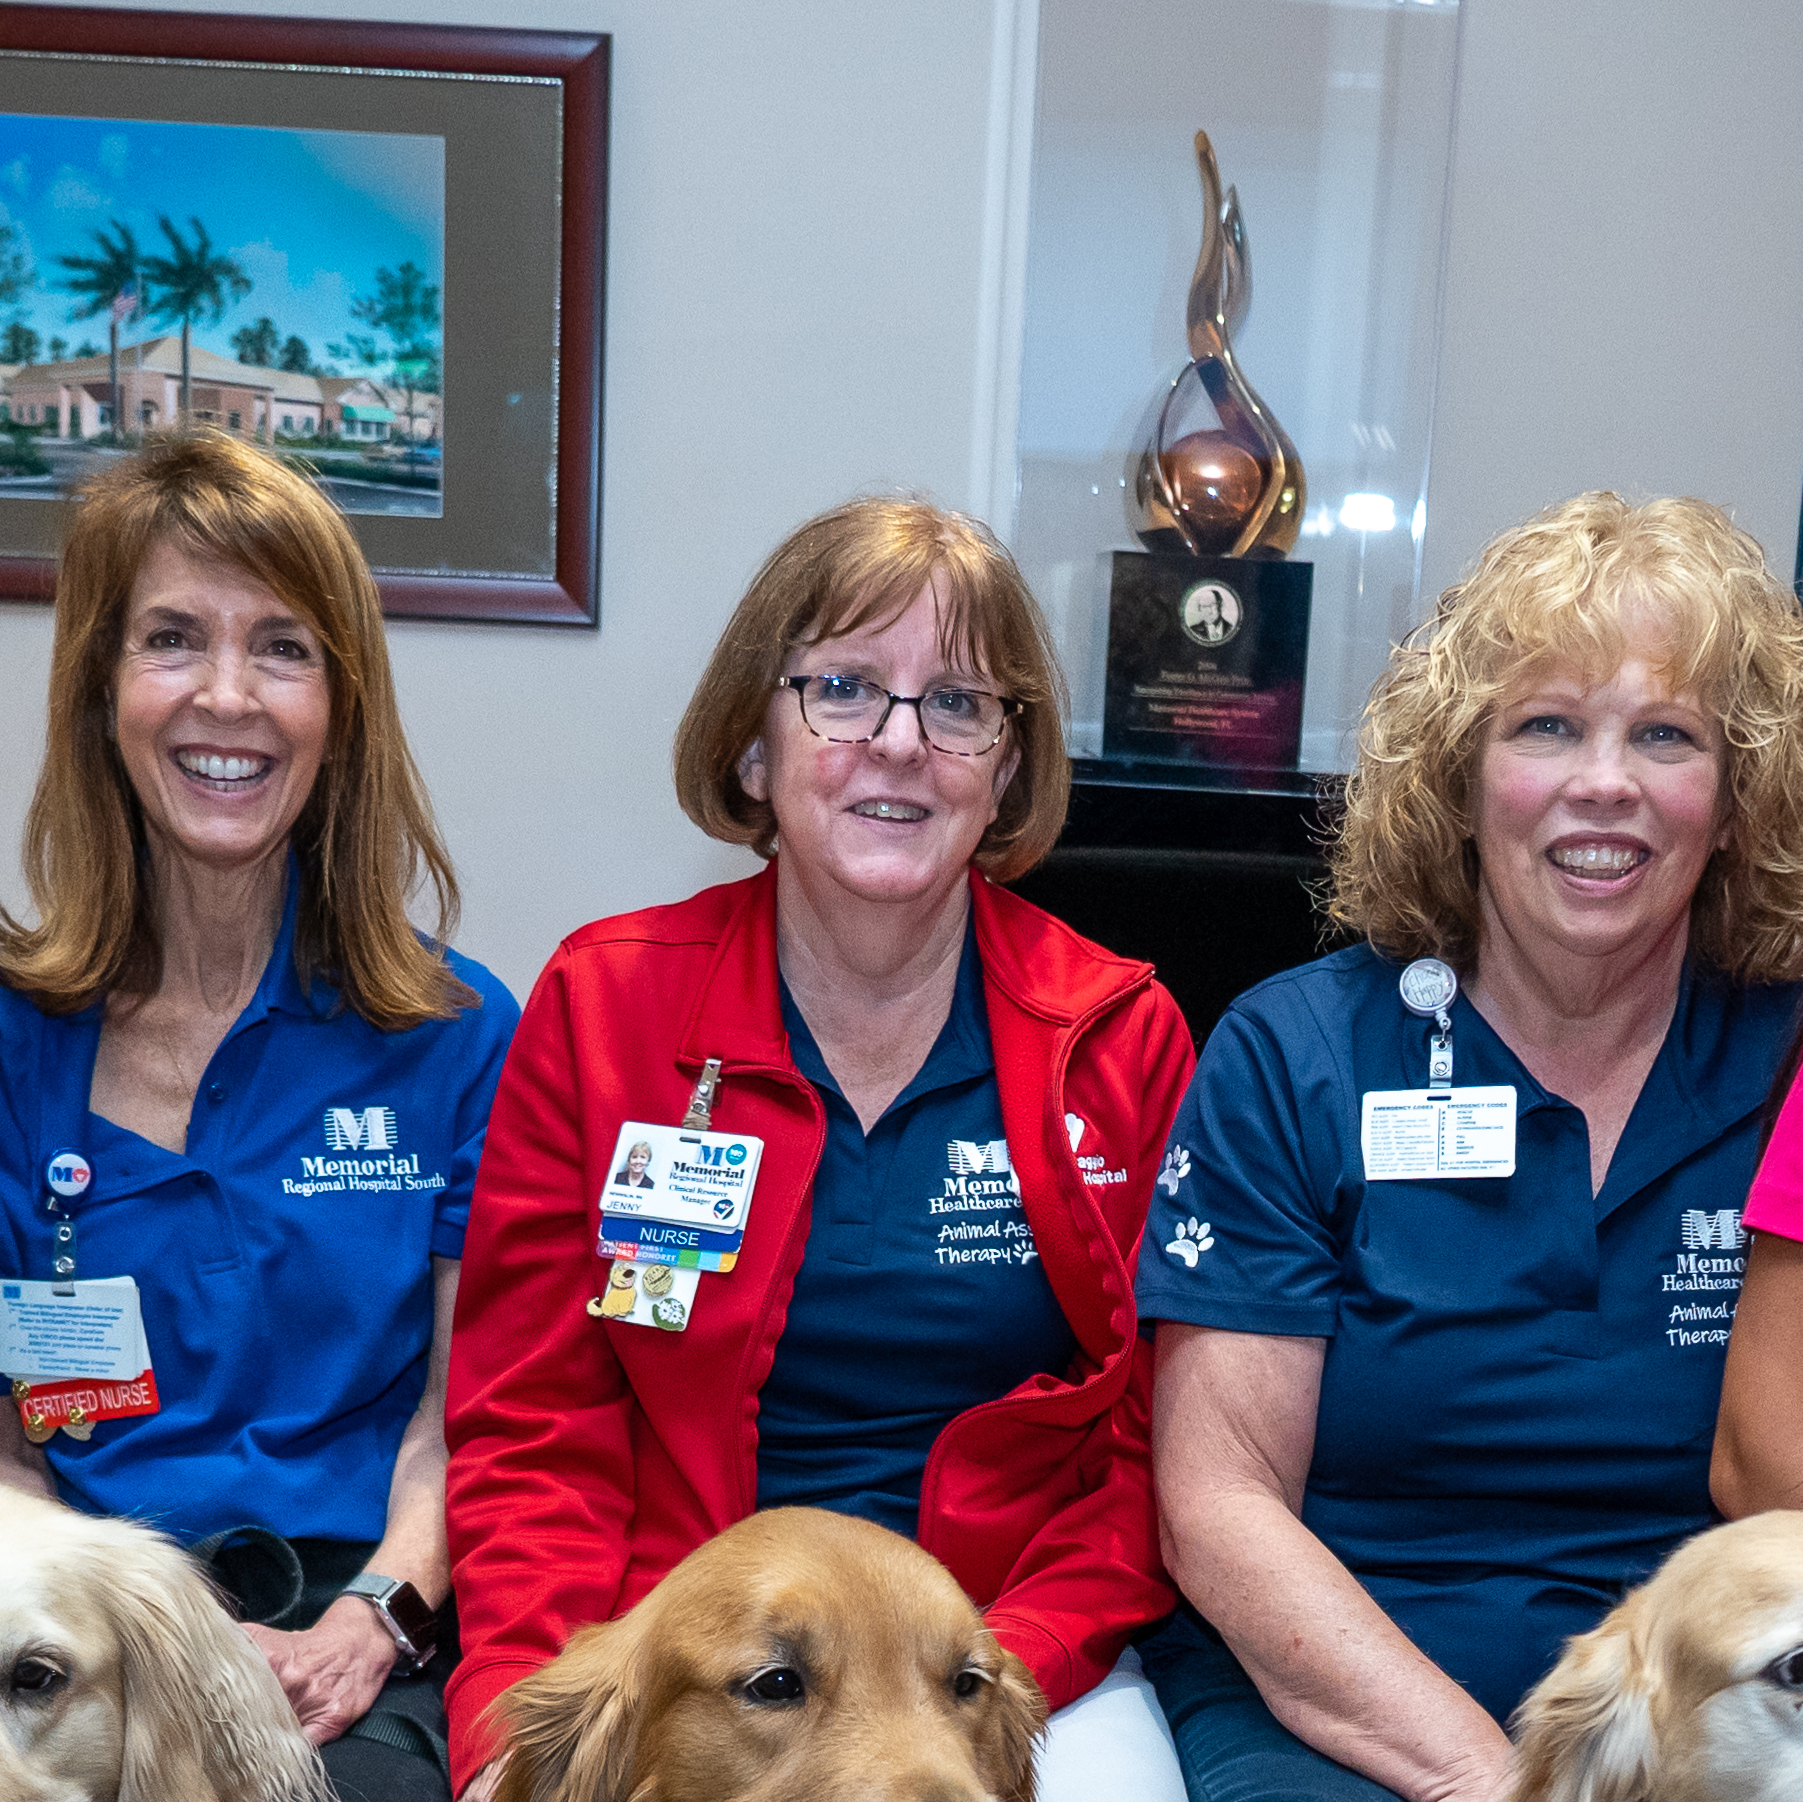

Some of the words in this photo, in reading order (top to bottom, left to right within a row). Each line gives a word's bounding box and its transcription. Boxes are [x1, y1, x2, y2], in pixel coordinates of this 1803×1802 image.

[301, 1153, 421, 1178] Memorial
[673, 1161, 745, 1179] Memorial
[282, 1176, 346, 1197] Regional
[349, 1175, 403, 1193] Hospital
[404, 1172, 447, 1191] South
[669, 1172, 707, 1184] Regional
[708, 1176, 743, 1188] Hospital
[607, 1200, 642, 1211] JENNY
[639, 1227, 701, 1246] NURSE
[937, 1220, 1001, 1243] Animal
[935, 1246, 1013, 1265] Therapy
[1668, 1301, 1730, 1324] Animal
[1665, 1328, 1732, 1346] Therap
[23, 1390, 98, 1419] CERTIFIED
[100, 1382, 152, 1412] NURSE
